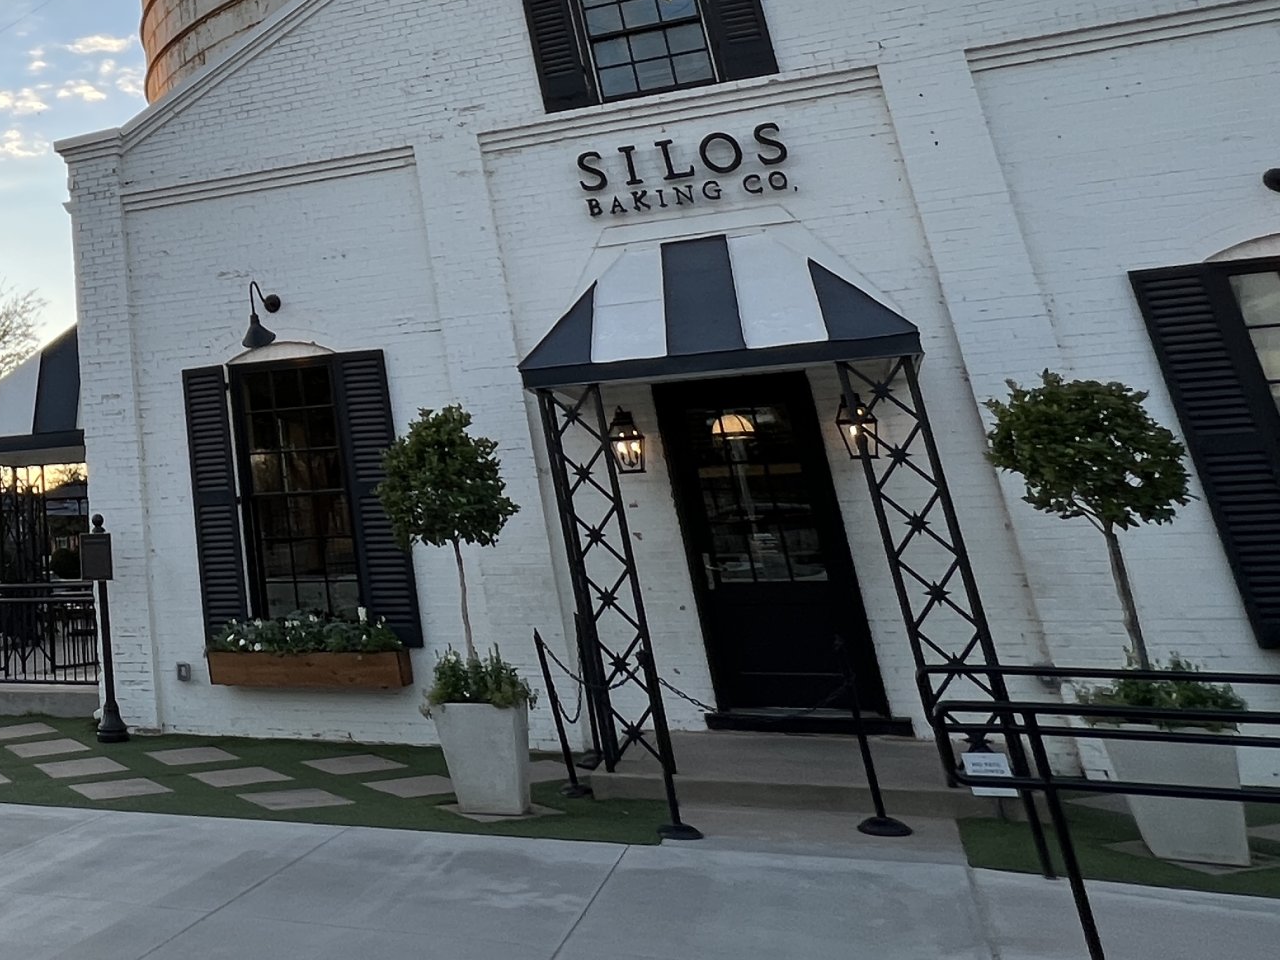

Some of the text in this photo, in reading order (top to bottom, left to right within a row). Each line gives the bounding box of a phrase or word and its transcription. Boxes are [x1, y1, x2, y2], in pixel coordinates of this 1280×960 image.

[577, 122, 788, 191] SILOS
[585, 170, 799, 217] BAKING CO.
